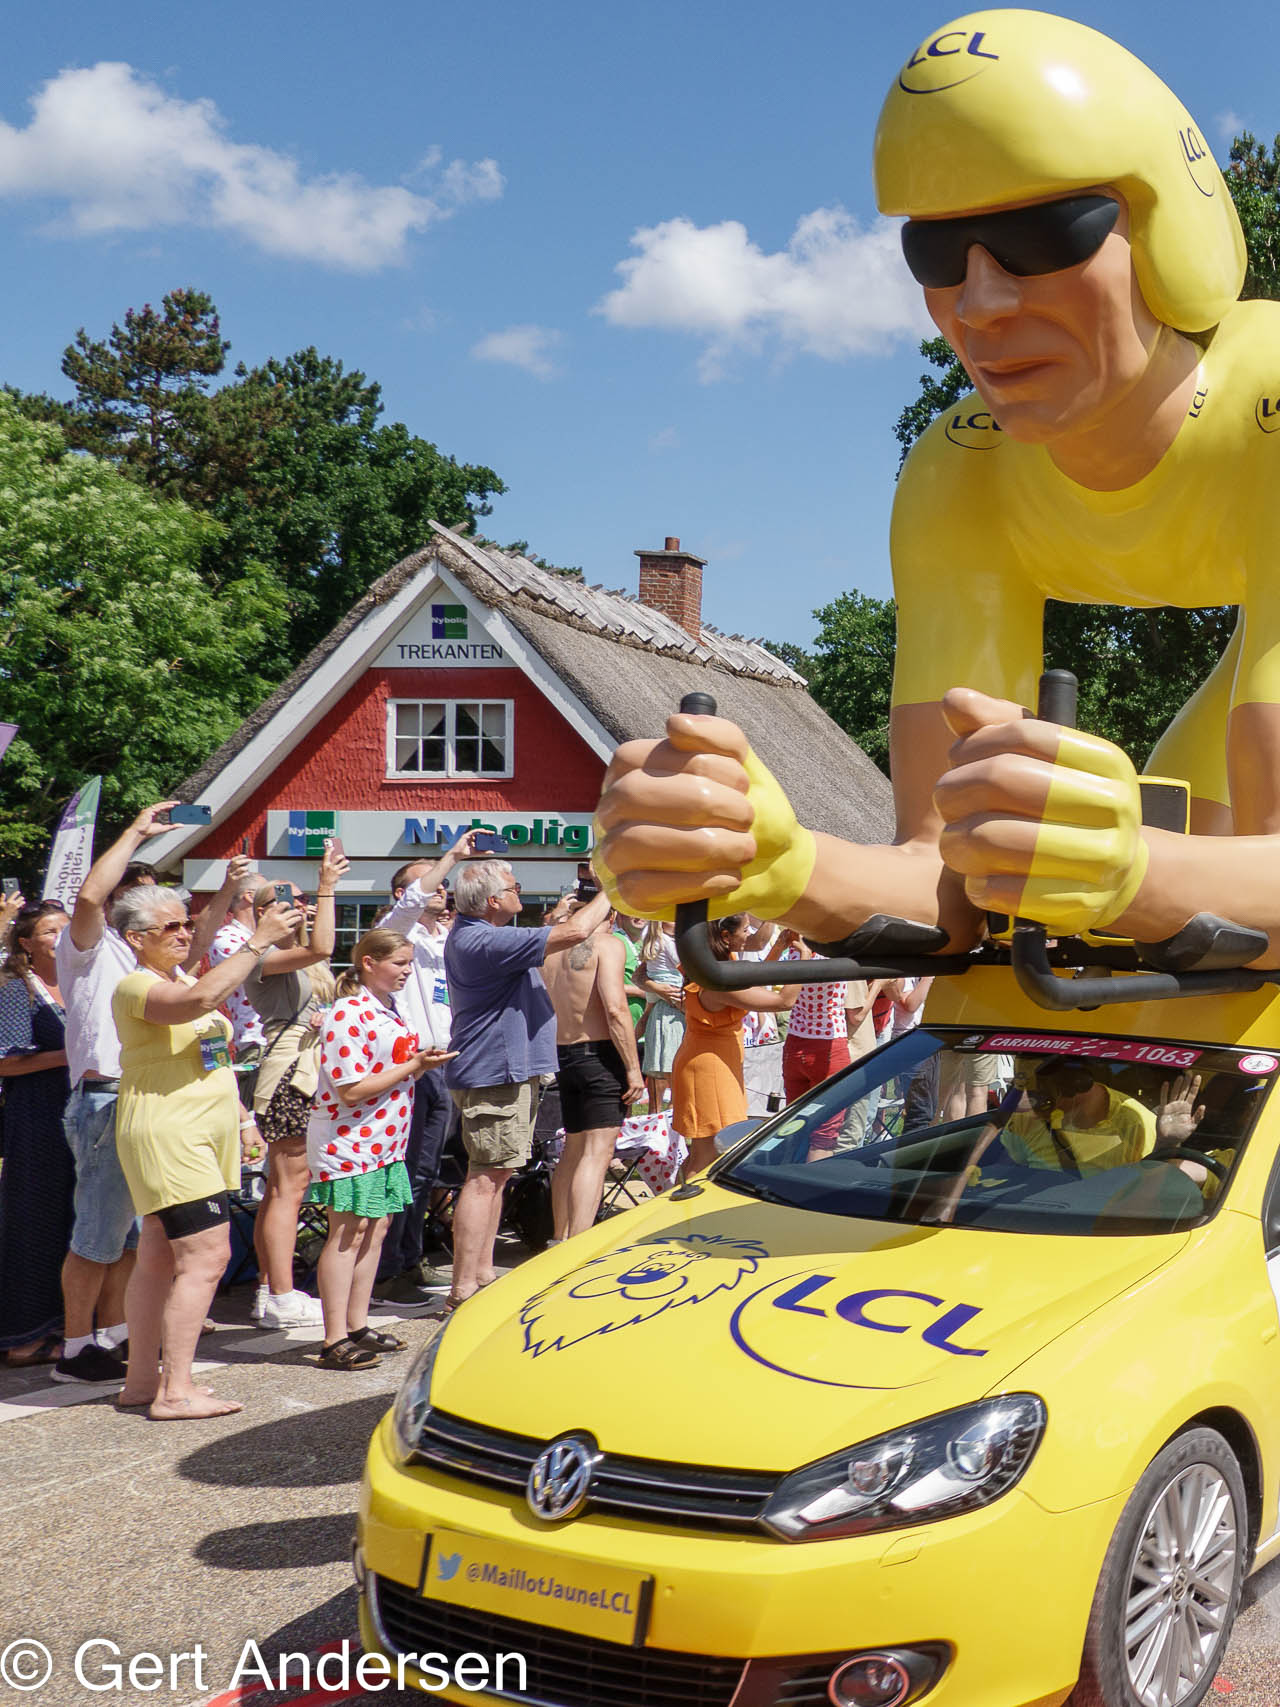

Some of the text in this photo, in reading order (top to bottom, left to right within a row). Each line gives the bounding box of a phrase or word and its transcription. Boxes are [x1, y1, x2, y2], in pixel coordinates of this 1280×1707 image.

[907, 31, 999, 69] LCL
[1188, 388, 1208, 418] LCL
[397, 644, 503, 660] TREKANTEN
[288, 827, 336, 838] Nybolig
[989, 1037, 1196, 1065] CARAVANE 1063
[772, 1274, 990, 1357] LCL
[465, 1562, 634, 1615] @MaillotJauneLCL
